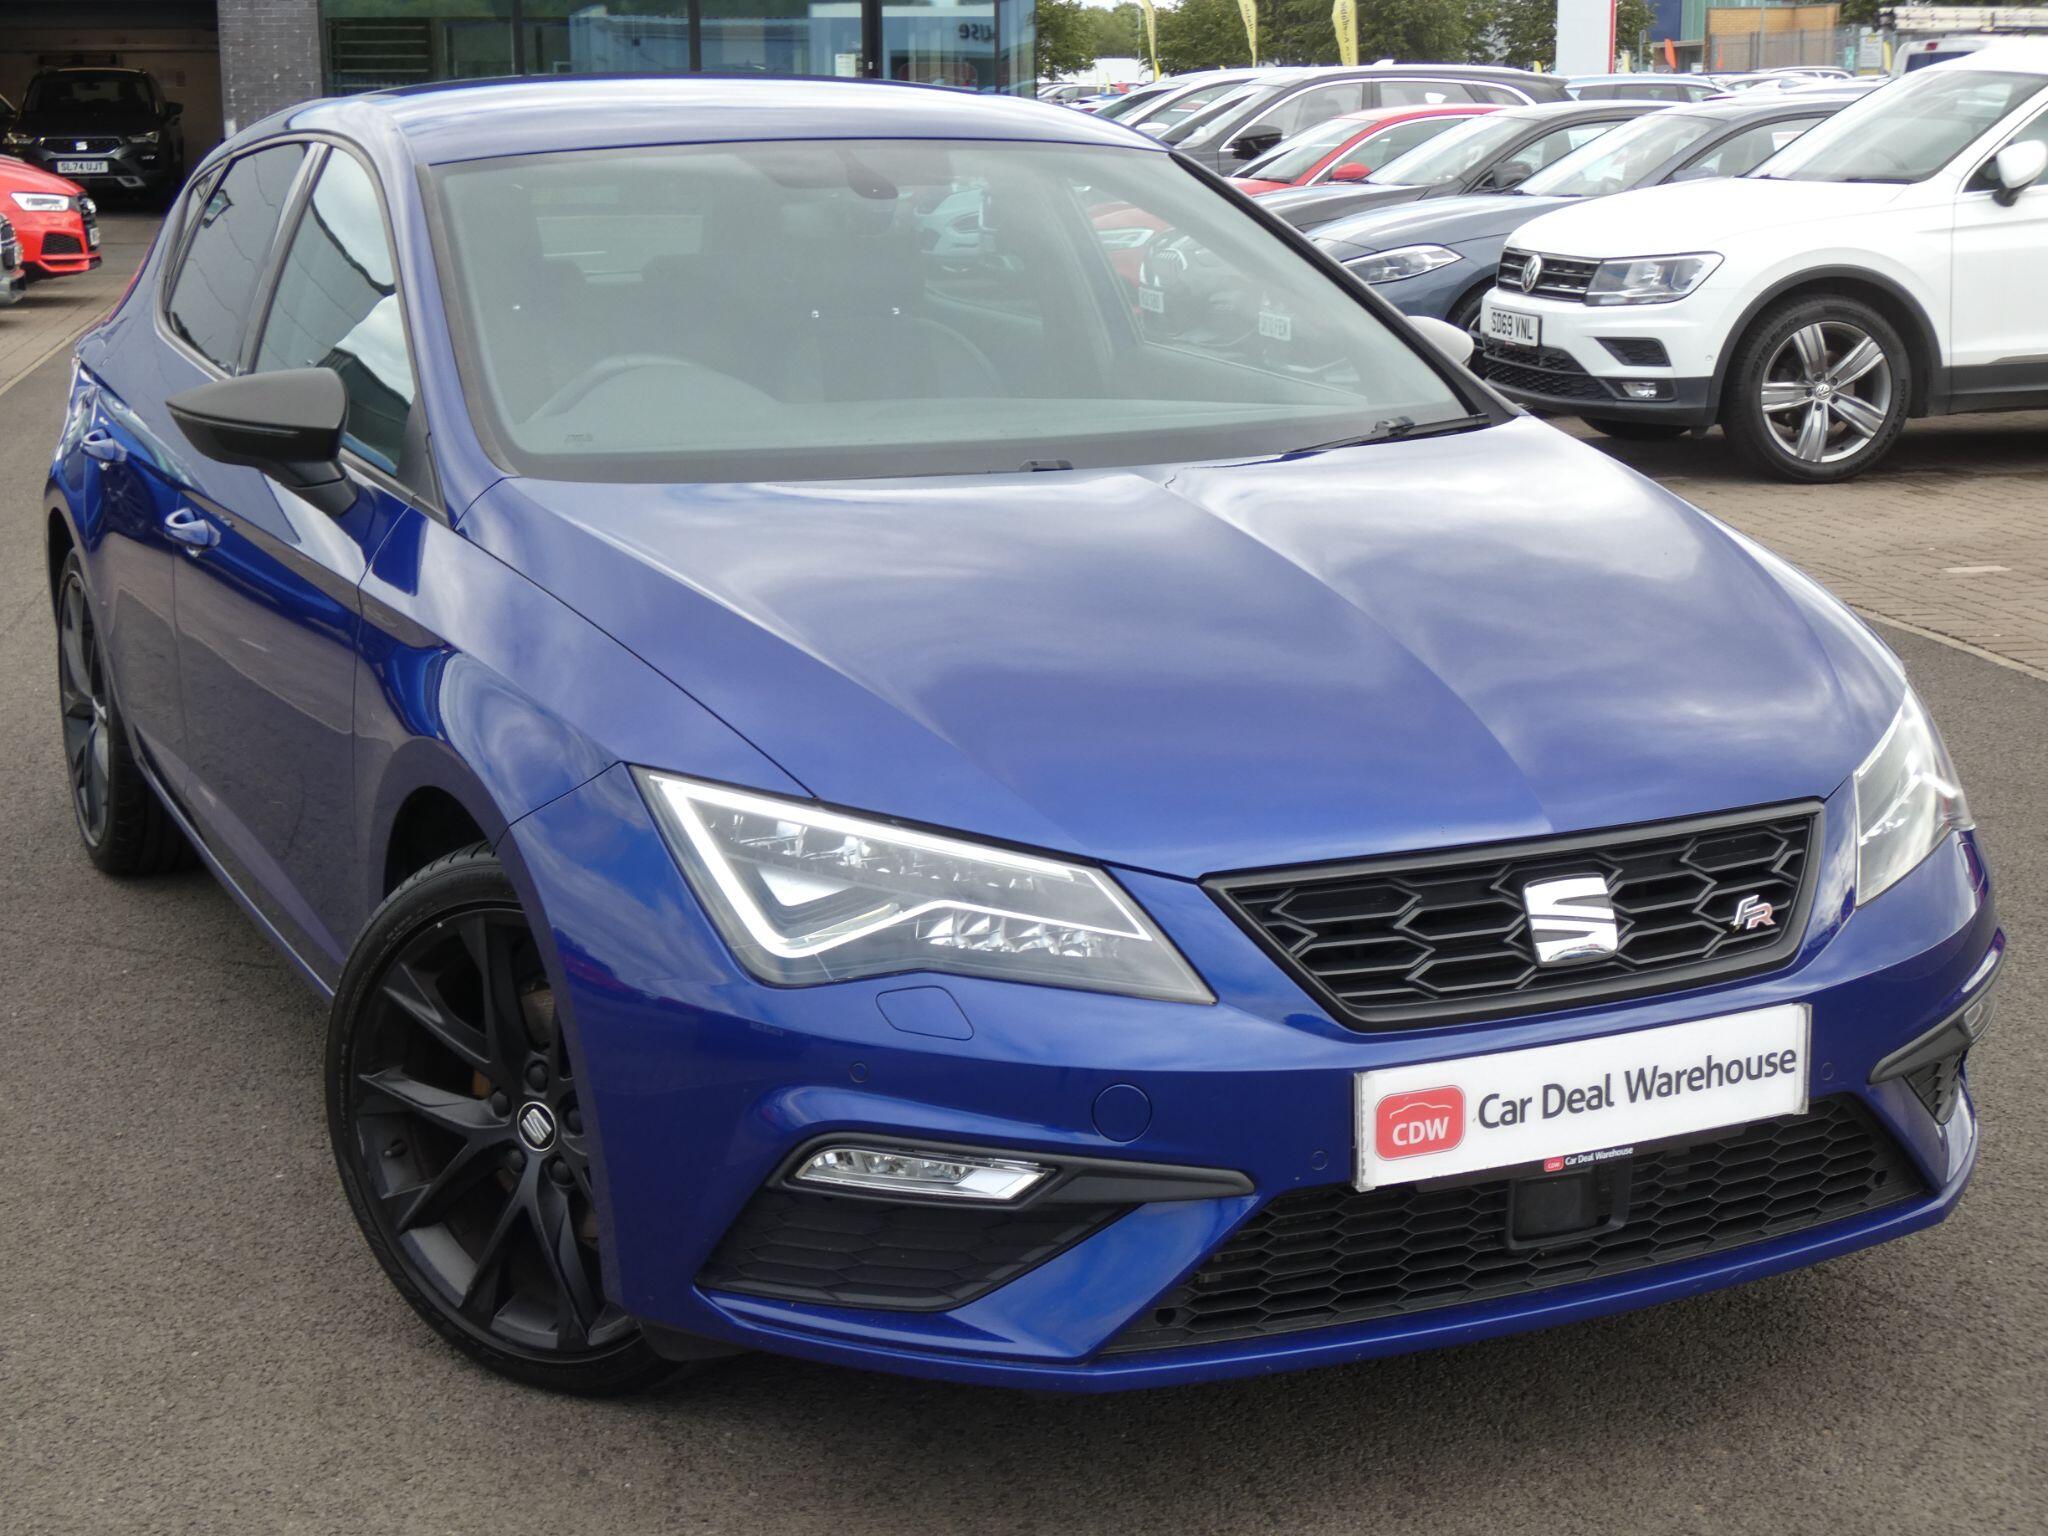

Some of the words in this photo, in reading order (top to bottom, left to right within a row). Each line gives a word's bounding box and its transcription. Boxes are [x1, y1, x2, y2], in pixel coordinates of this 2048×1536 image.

[61, 162, 84, 171] SL74
[86, 162, 103, 171] UJT
[1491, 311, 1513, 336] SD69
[1515, 316, 1533, 340] VNL
[1733, 894, 1775, 930] FR
[1478, 1093, 1533, 1129] Car
[1542, 1073, 1615, 1119] Deal
[1624, 1049, 1797, 1103] Warehouse
[1392, 1116, 1449, 1146] CDW
[1564, 1156, 1577, 1166] Car
[1578, 1152, 1594, 1164] Deal
[1595, 1147, 1634, 1160] Warehouse
